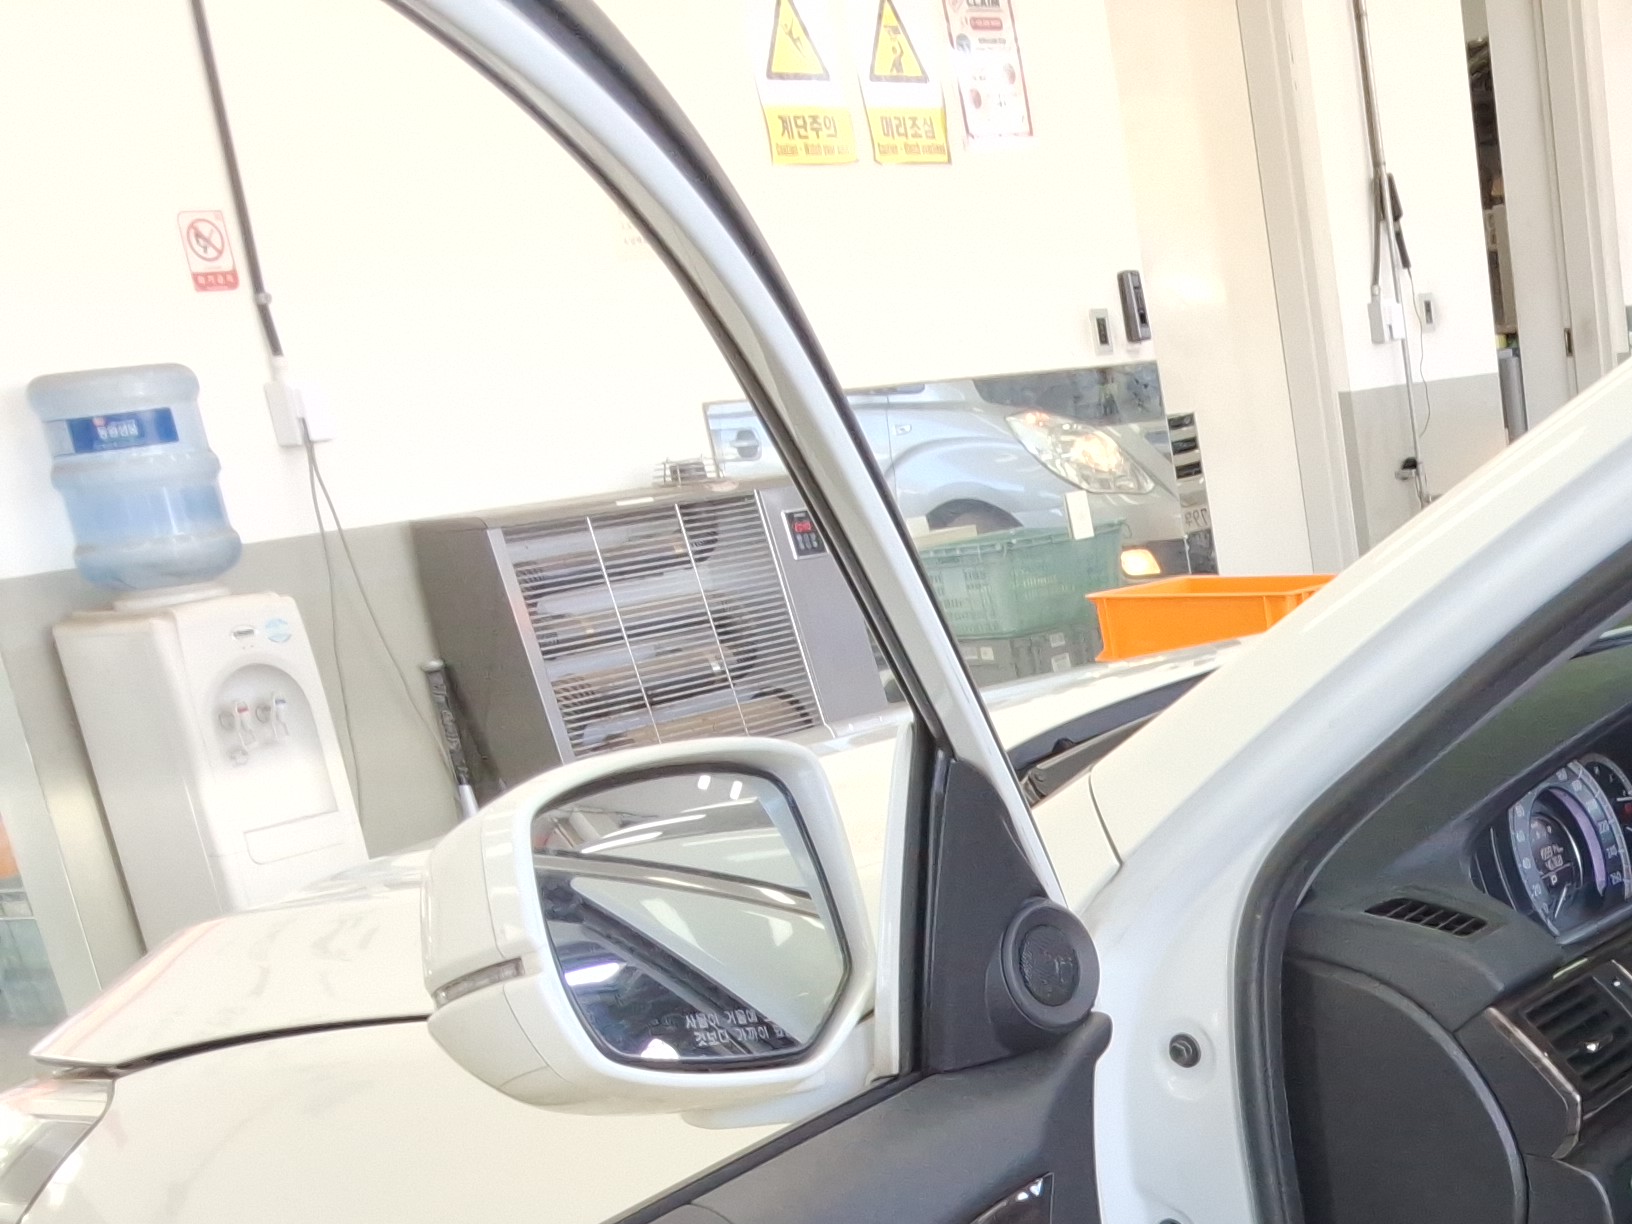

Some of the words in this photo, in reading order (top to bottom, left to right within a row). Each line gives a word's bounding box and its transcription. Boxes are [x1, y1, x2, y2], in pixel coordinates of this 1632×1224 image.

[780, 114, 837, 140] 계단주의
[881, 115, 936, 140] 머리조심
[685, 1013, 720, 1029] 사물이
[694, 1030, 730, 1047] 것보다
[735, 1026, 770, 1041] 가까이
